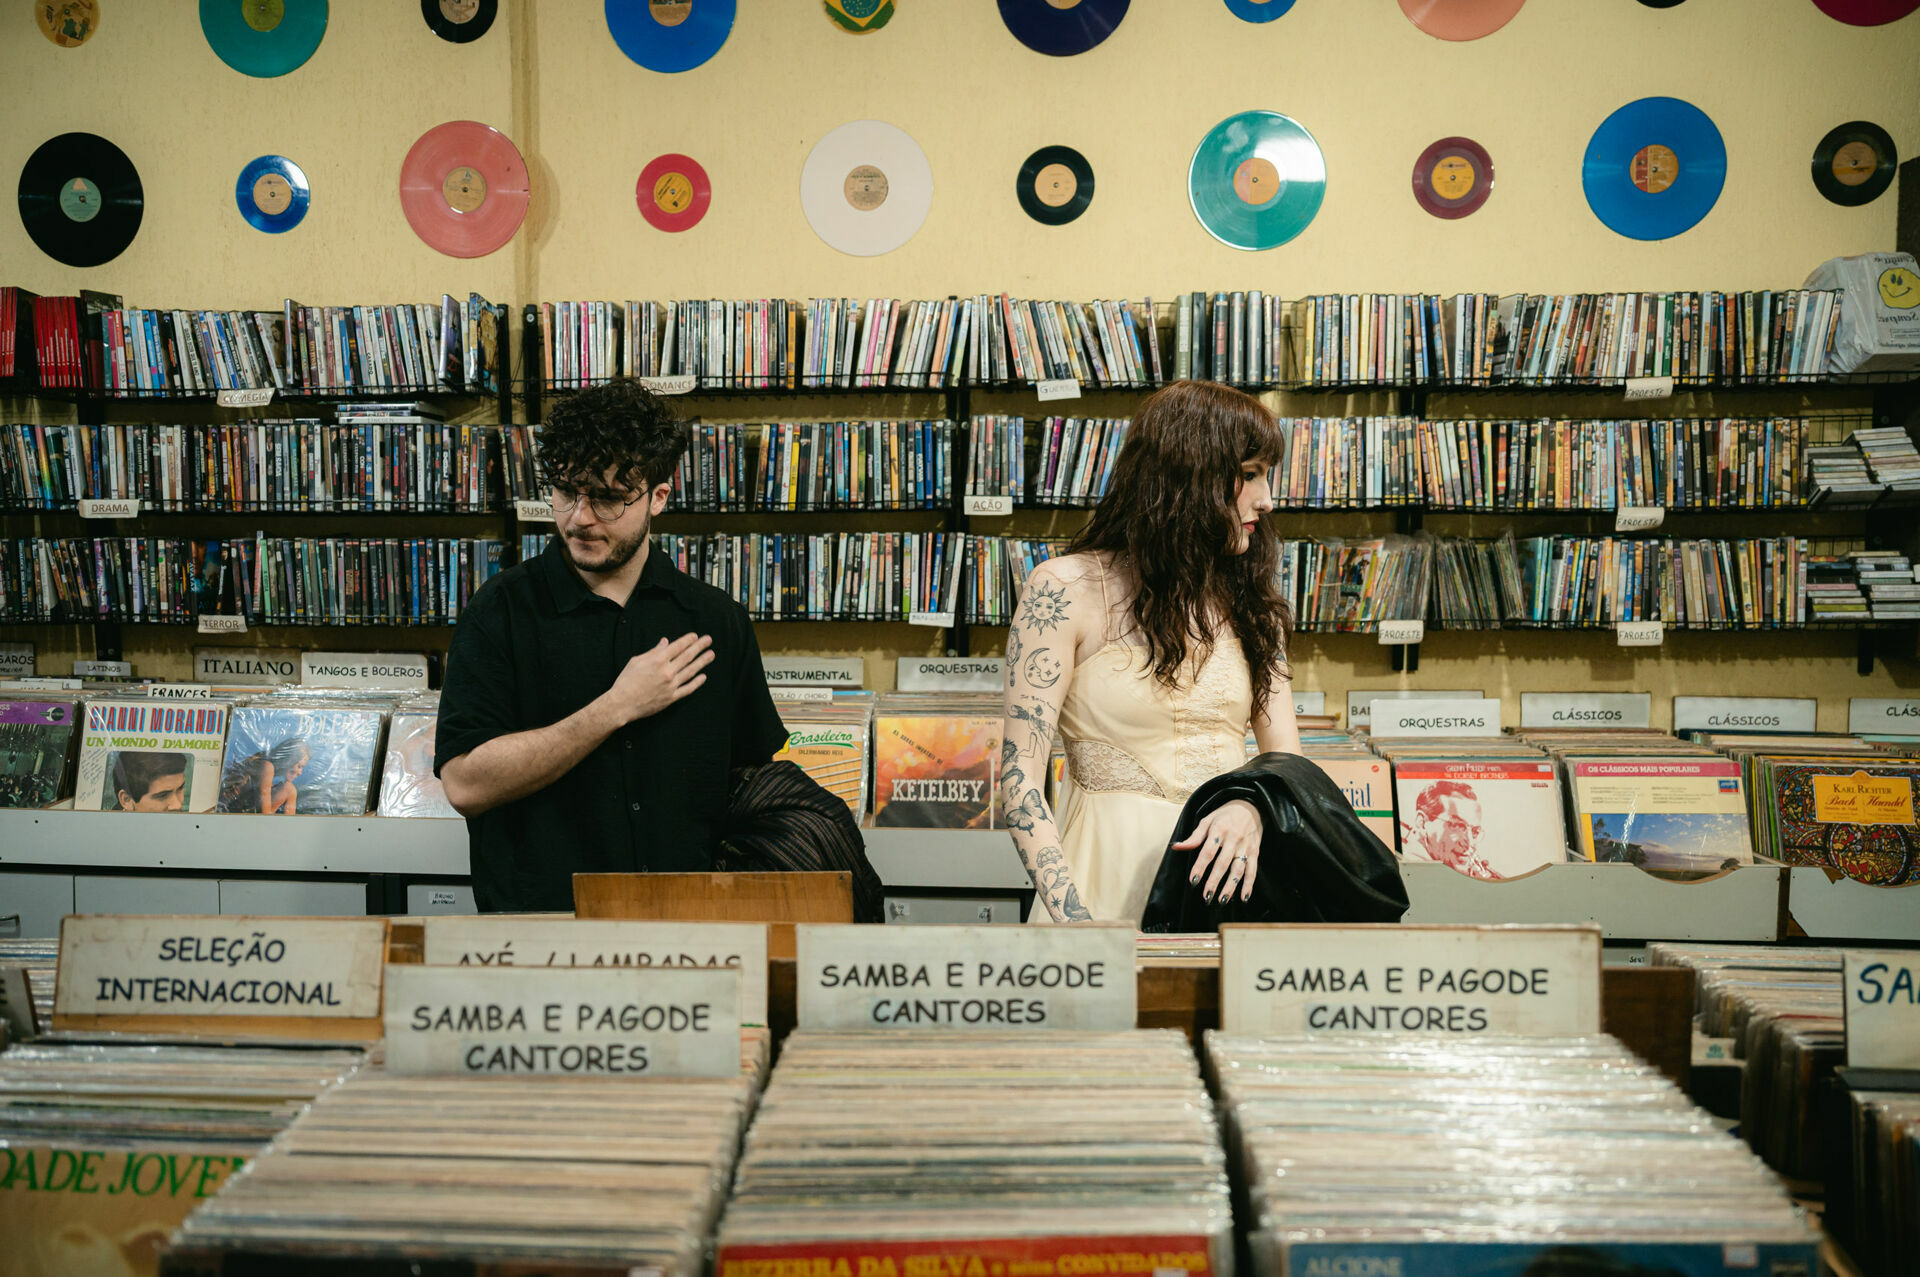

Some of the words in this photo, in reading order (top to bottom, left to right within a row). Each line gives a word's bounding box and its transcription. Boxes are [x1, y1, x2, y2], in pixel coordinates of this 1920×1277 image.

[643, 380, 693, 390] OMANCE
[91, 503, 130, 513] DRAMA
[521, 506, 551, 515] SUSPE
[973, 499, 1003, 511] AÇÃO
[204, 619, 240, 628] TERROR
[1378, 630, 1421, 640] FAROESTE
[1619, 630, 1661, 641] FAROESTE
[87, 665, 122, 673] LATINOS
[203, 659, 294, 676] ITALIANO
[309, 665, 357, 677] TANGOS
[361, 667, 368, 677] E
[372, 666, 424, 678] BOLEROS
[919, 663, 999, 675] ORQUESTRAS
[764, 670, 853, 681] NSTRUMENTAL
[1552, 708, 1622, 721] CLÁSSICOS
[1886, 703, 1920, 717] CLÁS
[90, 706, 145, 733] GIANNI
[150, 707, 224, 735] MORANDI
[1399, 717, 1485, 729] ORQUESTRAS
[1707, 714, 1780, 726] CLÁSSICOS
[86, 737, 105, 747] UN
[109, 737, 158, 749] MONDO
[163, 738, 221, 750] D'AMORE
[789, 729, 853, 746] Brasileiro
[1587, 765, 1599, 773] OS
[1659, 766, 1701, 774] POPULARES
[890, 779, 985, 803] KETELBEY
[158, 932, 286, 966] SELEÇÃO
[820, 964, 931, 988] SAMBA
[947, 962, 965, 987] E
[978, 962, 1105, 988] PAGODE
[1255, 968, 1370, 993] SAMBA
[1385, 968, 1404, 993] E
[1418, 968, 1549, 995] PAGODE
[1857, 963, 1920, 1004] SA
[96, 977, 341, 1006] INTERNACIONAL
[410, 1005, 527, 1032] SAMBA
[543, 1004, 562, 1031] E
[577, 1004, 711, 1032] PAGODE
[872, 999, 1046, 1025] CANTORES
[1308, 1005, 1488, 1032] CANTORES
[465, 1044, 649, 1073] CANTORES
[107, 1151, 246, 1198] JOVE
